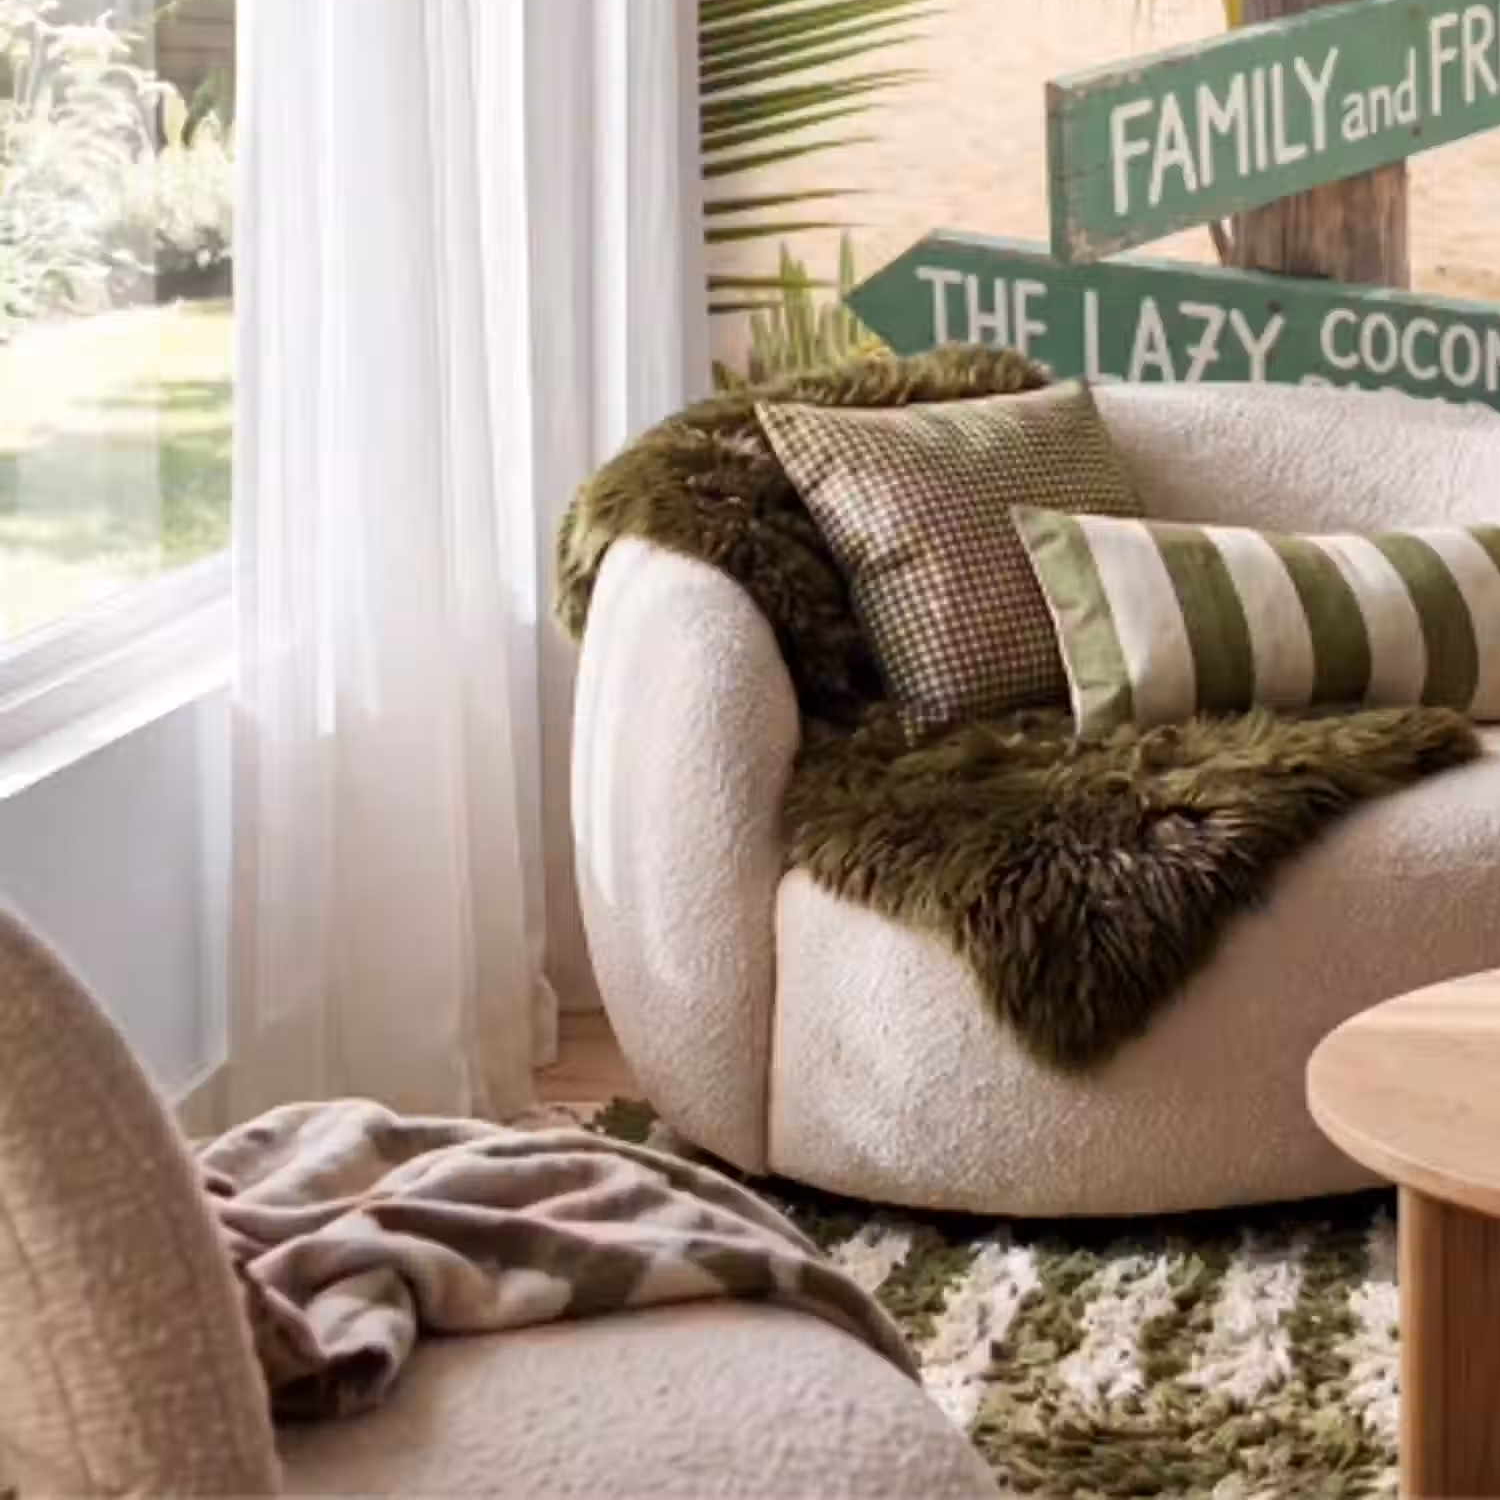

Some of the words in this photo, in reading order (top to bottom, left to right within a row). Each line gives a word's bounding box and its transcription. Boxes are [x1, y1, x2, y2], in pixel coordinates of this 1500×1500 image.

[1109, 47, 1339, 216] FAMILY
[1341, 59, 1418, 142] and
[915, 267, 1048, 355] THE
[1084, 290, 1286, 384] LAZY
